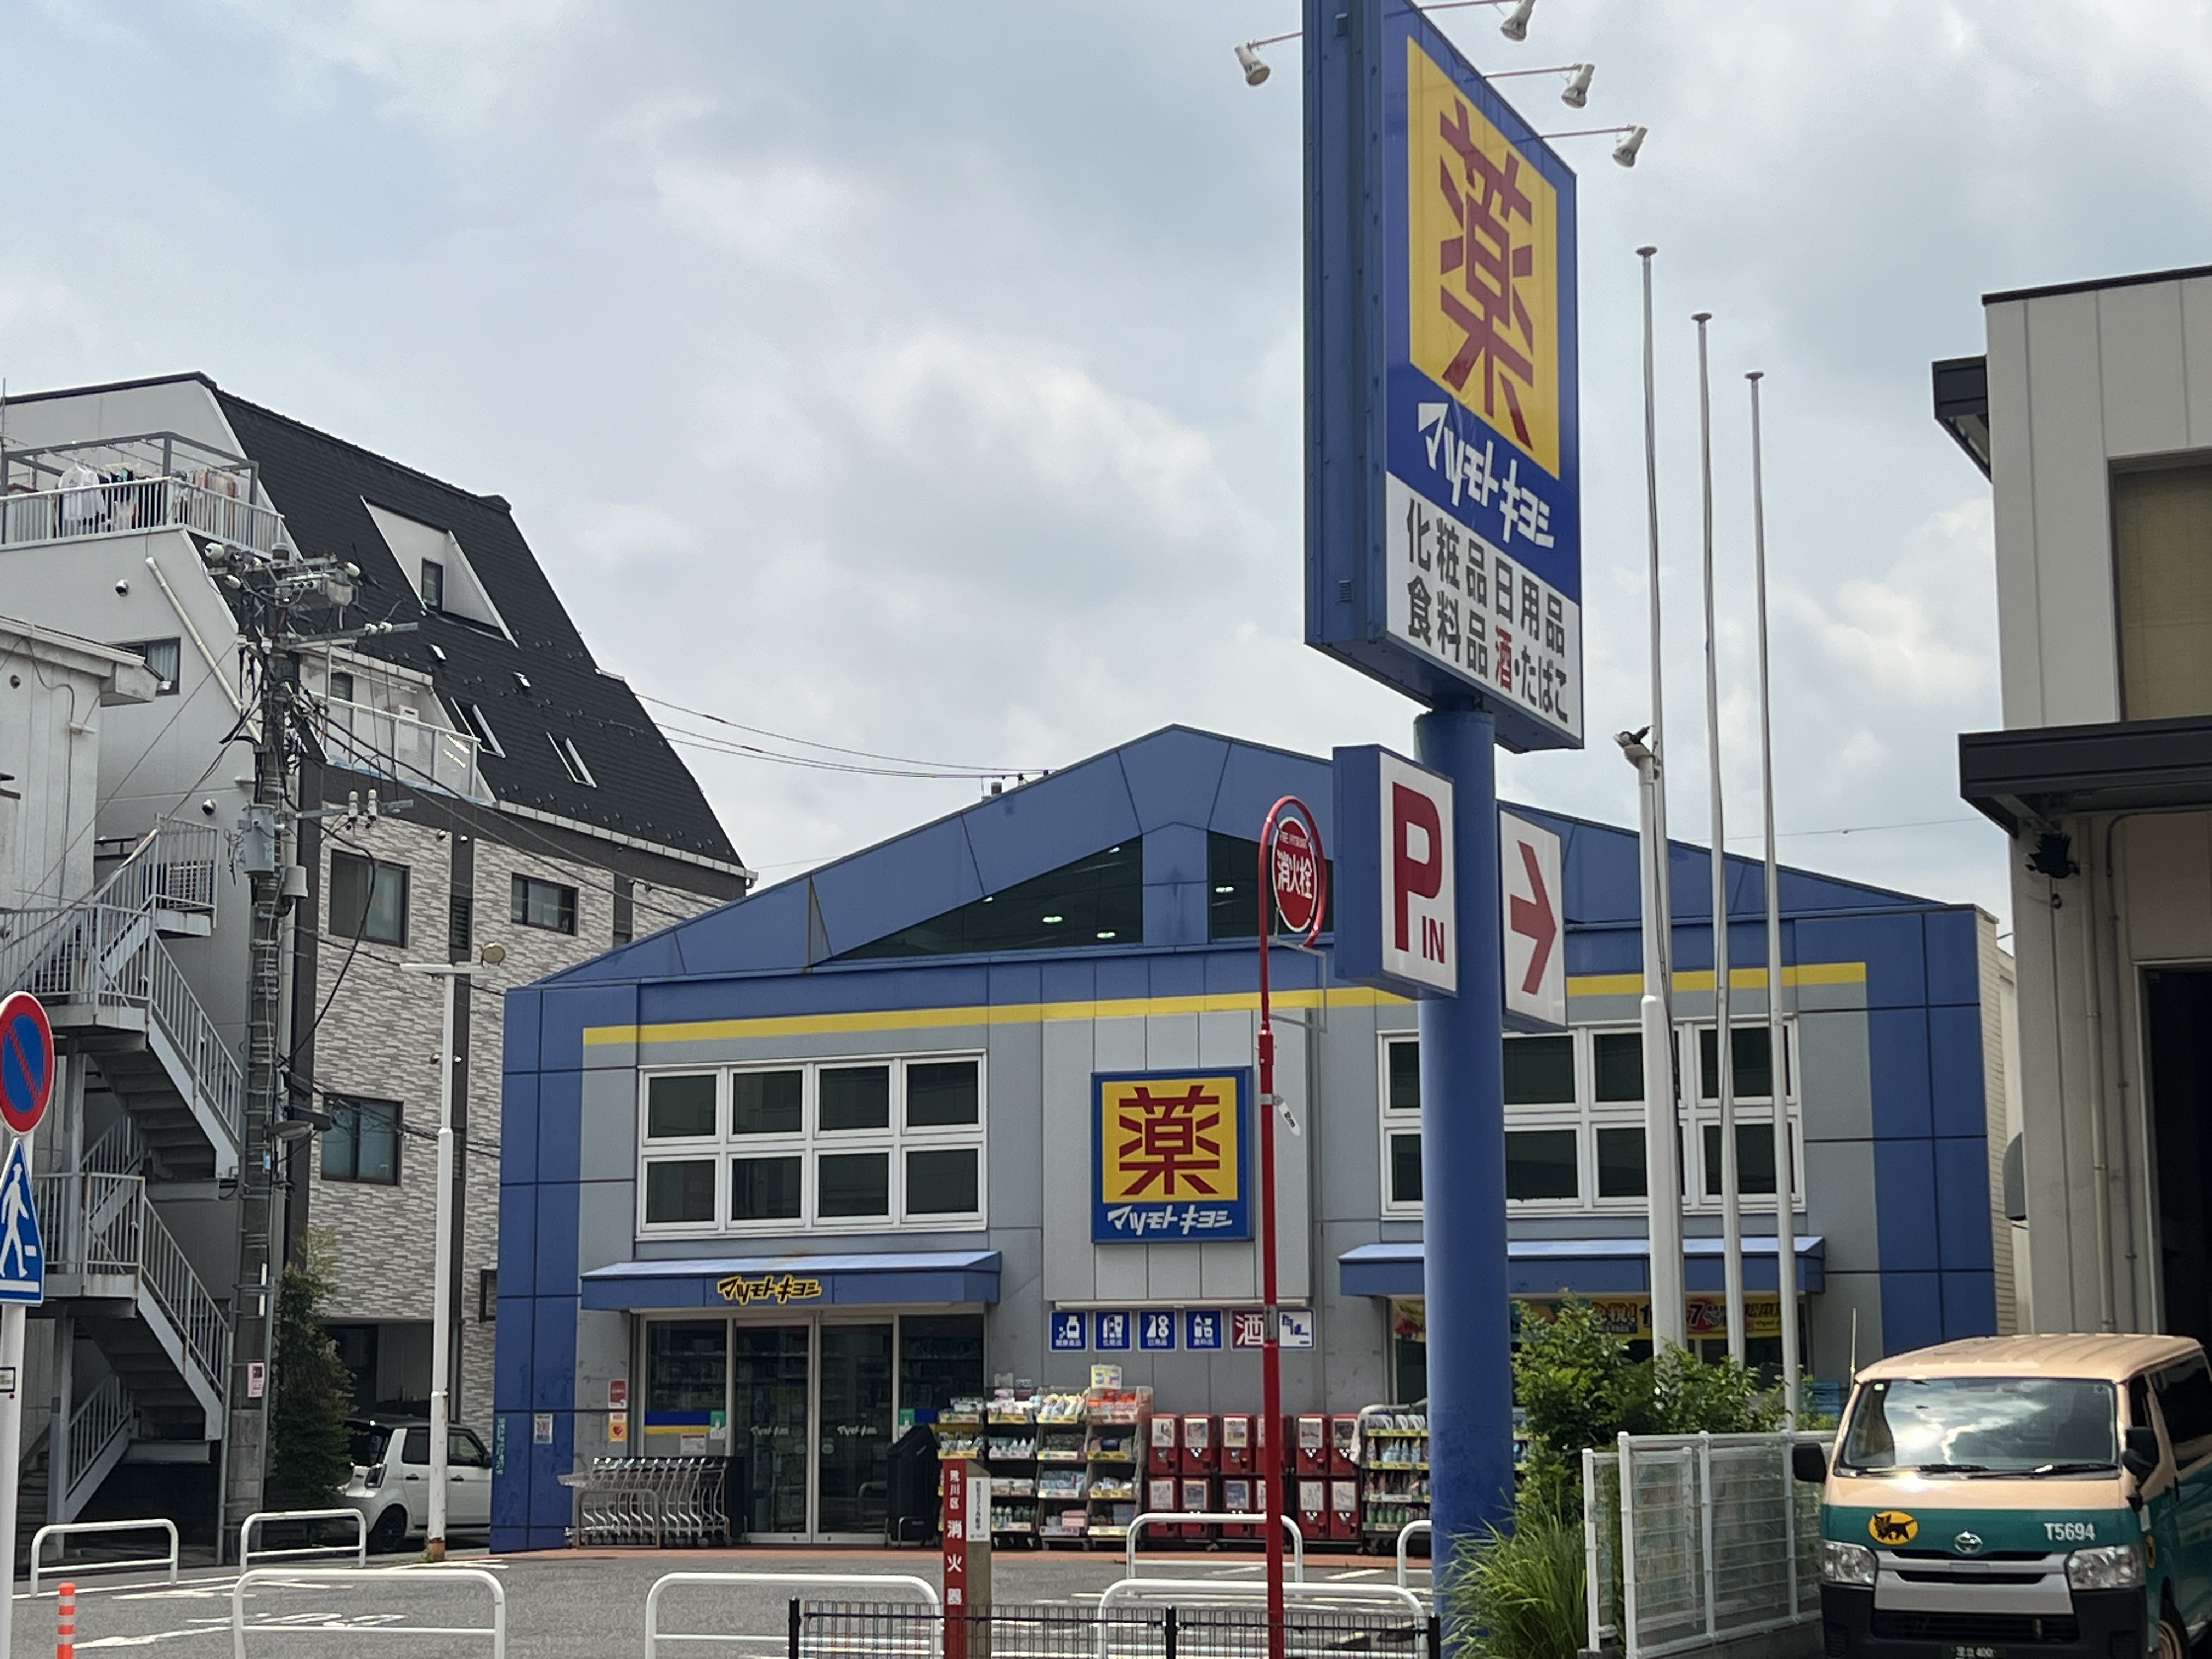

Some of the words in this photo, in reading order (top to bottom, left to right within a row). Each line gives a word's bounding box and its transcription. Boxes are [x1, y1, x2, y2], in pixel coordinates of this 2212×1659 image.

[1440, 94, 1533, 450] 薬
[1418, 402, 1554, 549] マツモトキヨシ
[1407, 498, 1565, 658] 化粧品日用品
[1277, 849, 1313, 899] 消火栓
[1392, 782, 1443, 952] P
[1422, 916, 1444, 964] IN
[1119, 1085, 1221, 1195] 薬
[1107, 1204, 1233, 1236] マツモトキヨシ
[718, 1276, 821, 1304] マツモトキヨシ
[1235, 1313, 1264, 1345] 酒
[2044, 1522, 2096, 1541] T5694
